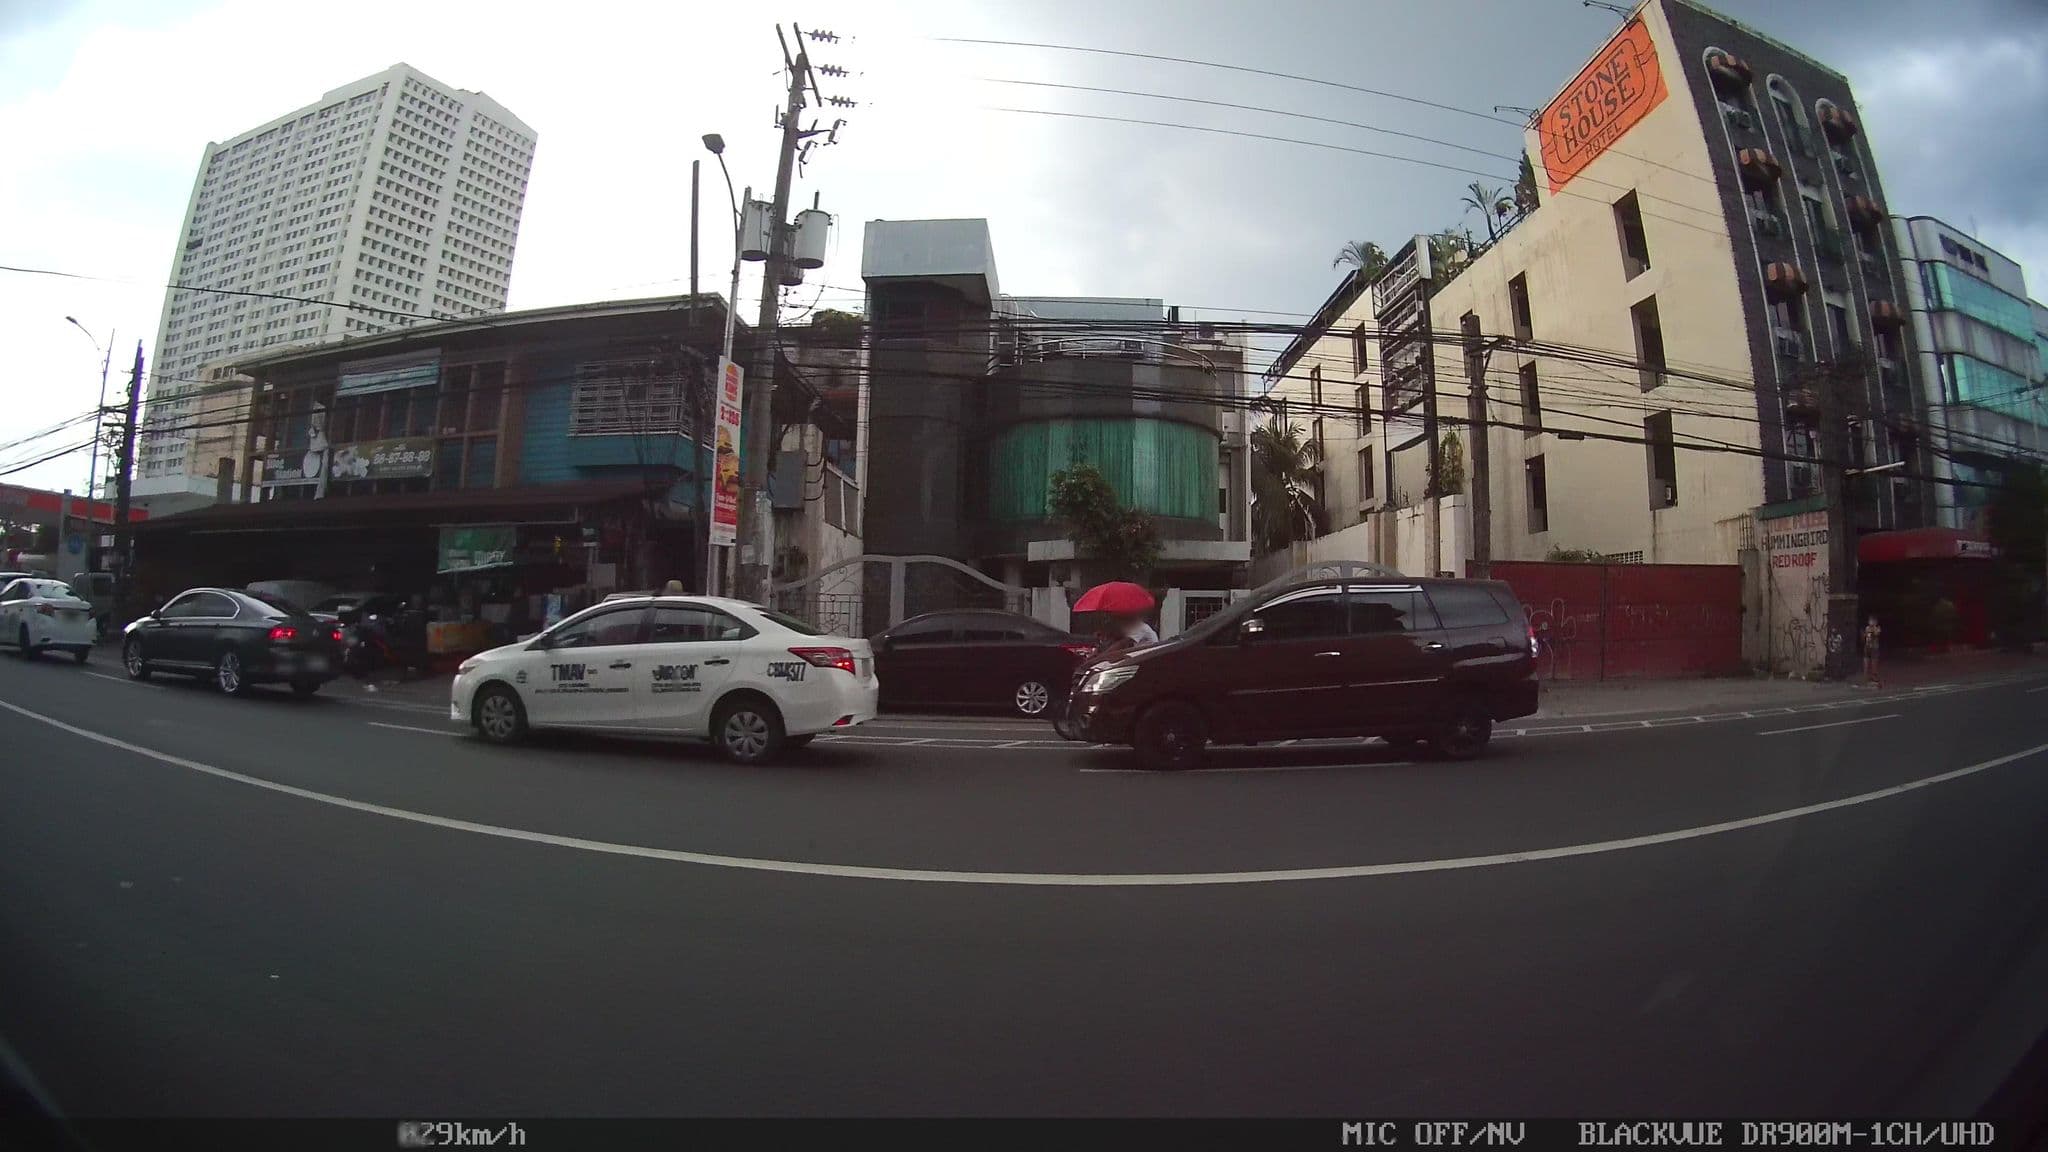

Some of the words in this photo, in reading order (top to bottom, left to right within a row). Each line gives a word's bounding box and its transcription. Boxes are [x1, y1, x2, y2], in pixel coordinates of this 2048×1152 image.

[1560, 49, 1629, 129] STONE
[1564, 72, 1636, 154] HOUSE
[1585, 122, 1622, 160] HOTEL
[1761, 529, 1829, 551] HUMMINGBIRD
[1772, 554, 1791, 568] RED
[1792, 552, 1818, 568] ROOF
